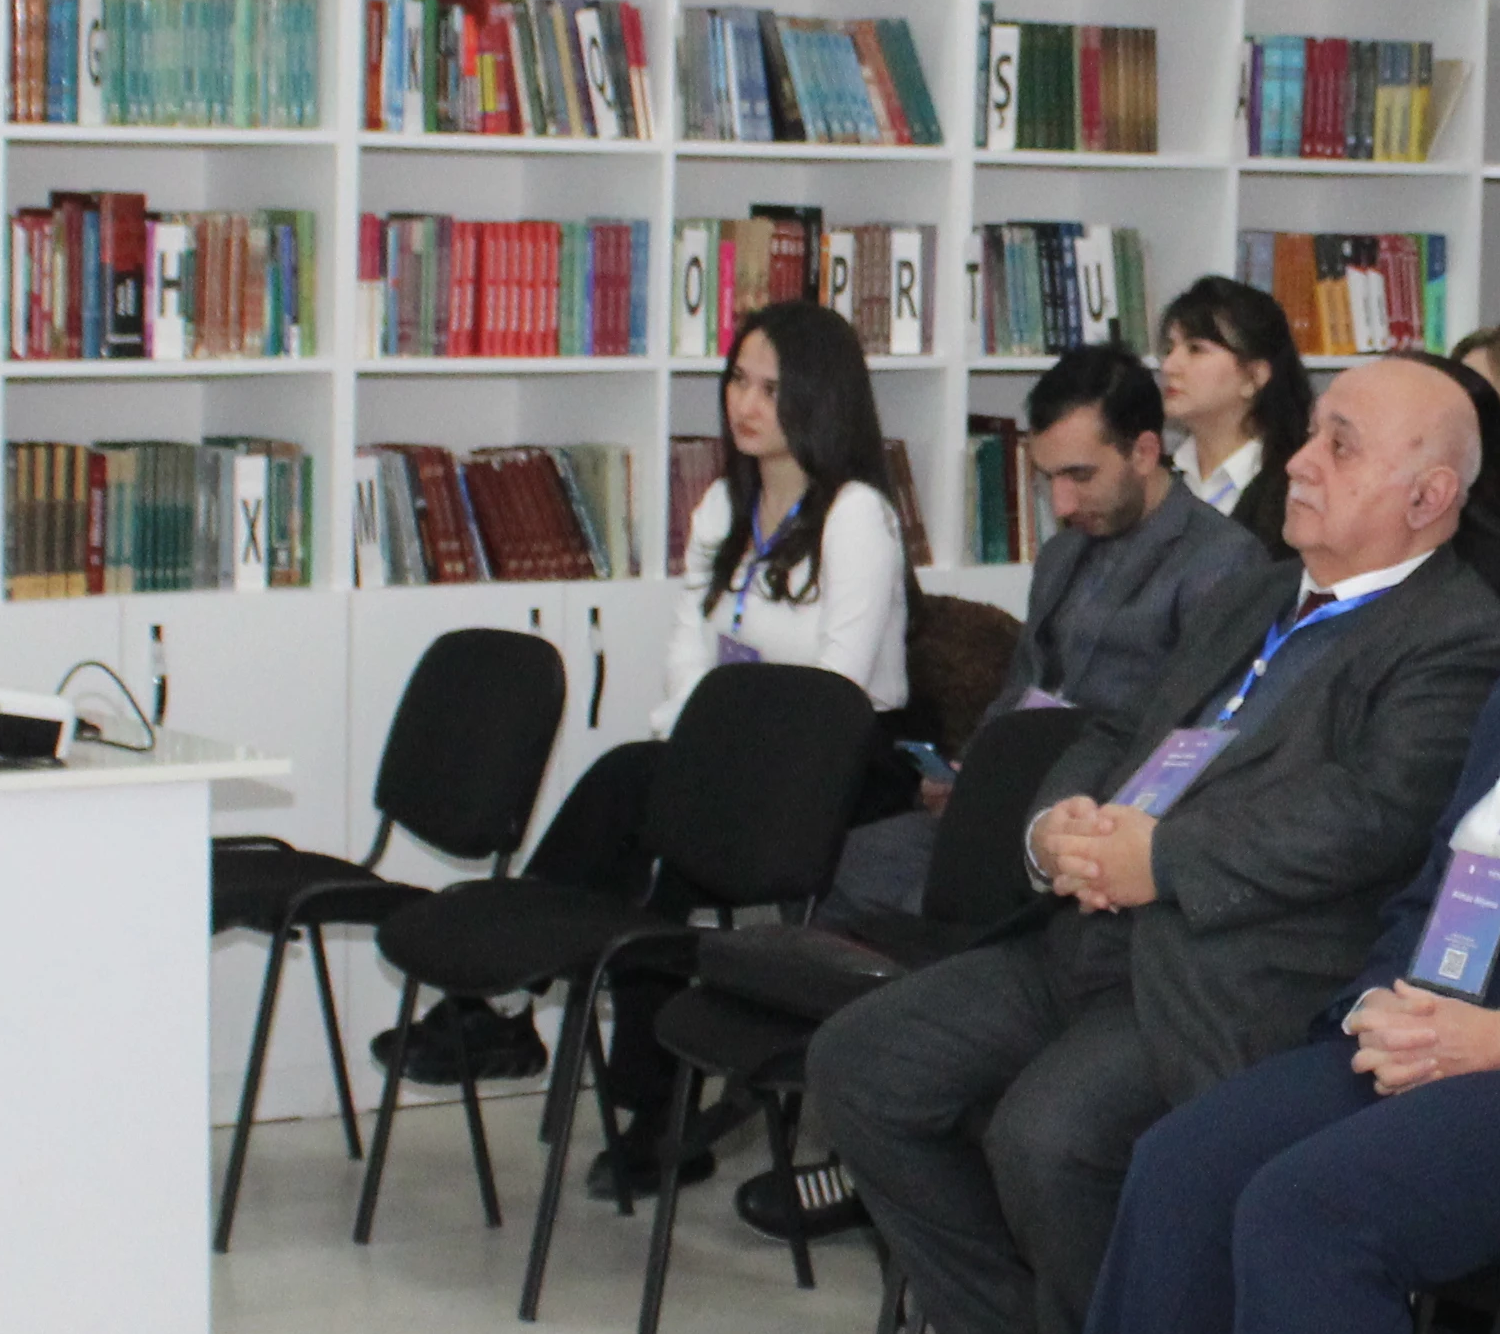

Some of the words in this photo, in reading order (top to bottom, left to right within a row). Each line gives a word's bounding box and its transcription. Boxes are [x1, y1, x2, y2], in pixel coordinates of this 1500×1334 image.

[995, 55, 1011, 129] Ş
[160, 250, 185, 318] H
[686, 256, 701, 315] O
[834, 258, 849, 313] P
[898, 259, 918, 319] R
[1085, 265, 1104, 322] U
[241, 497, 262, 564] X
